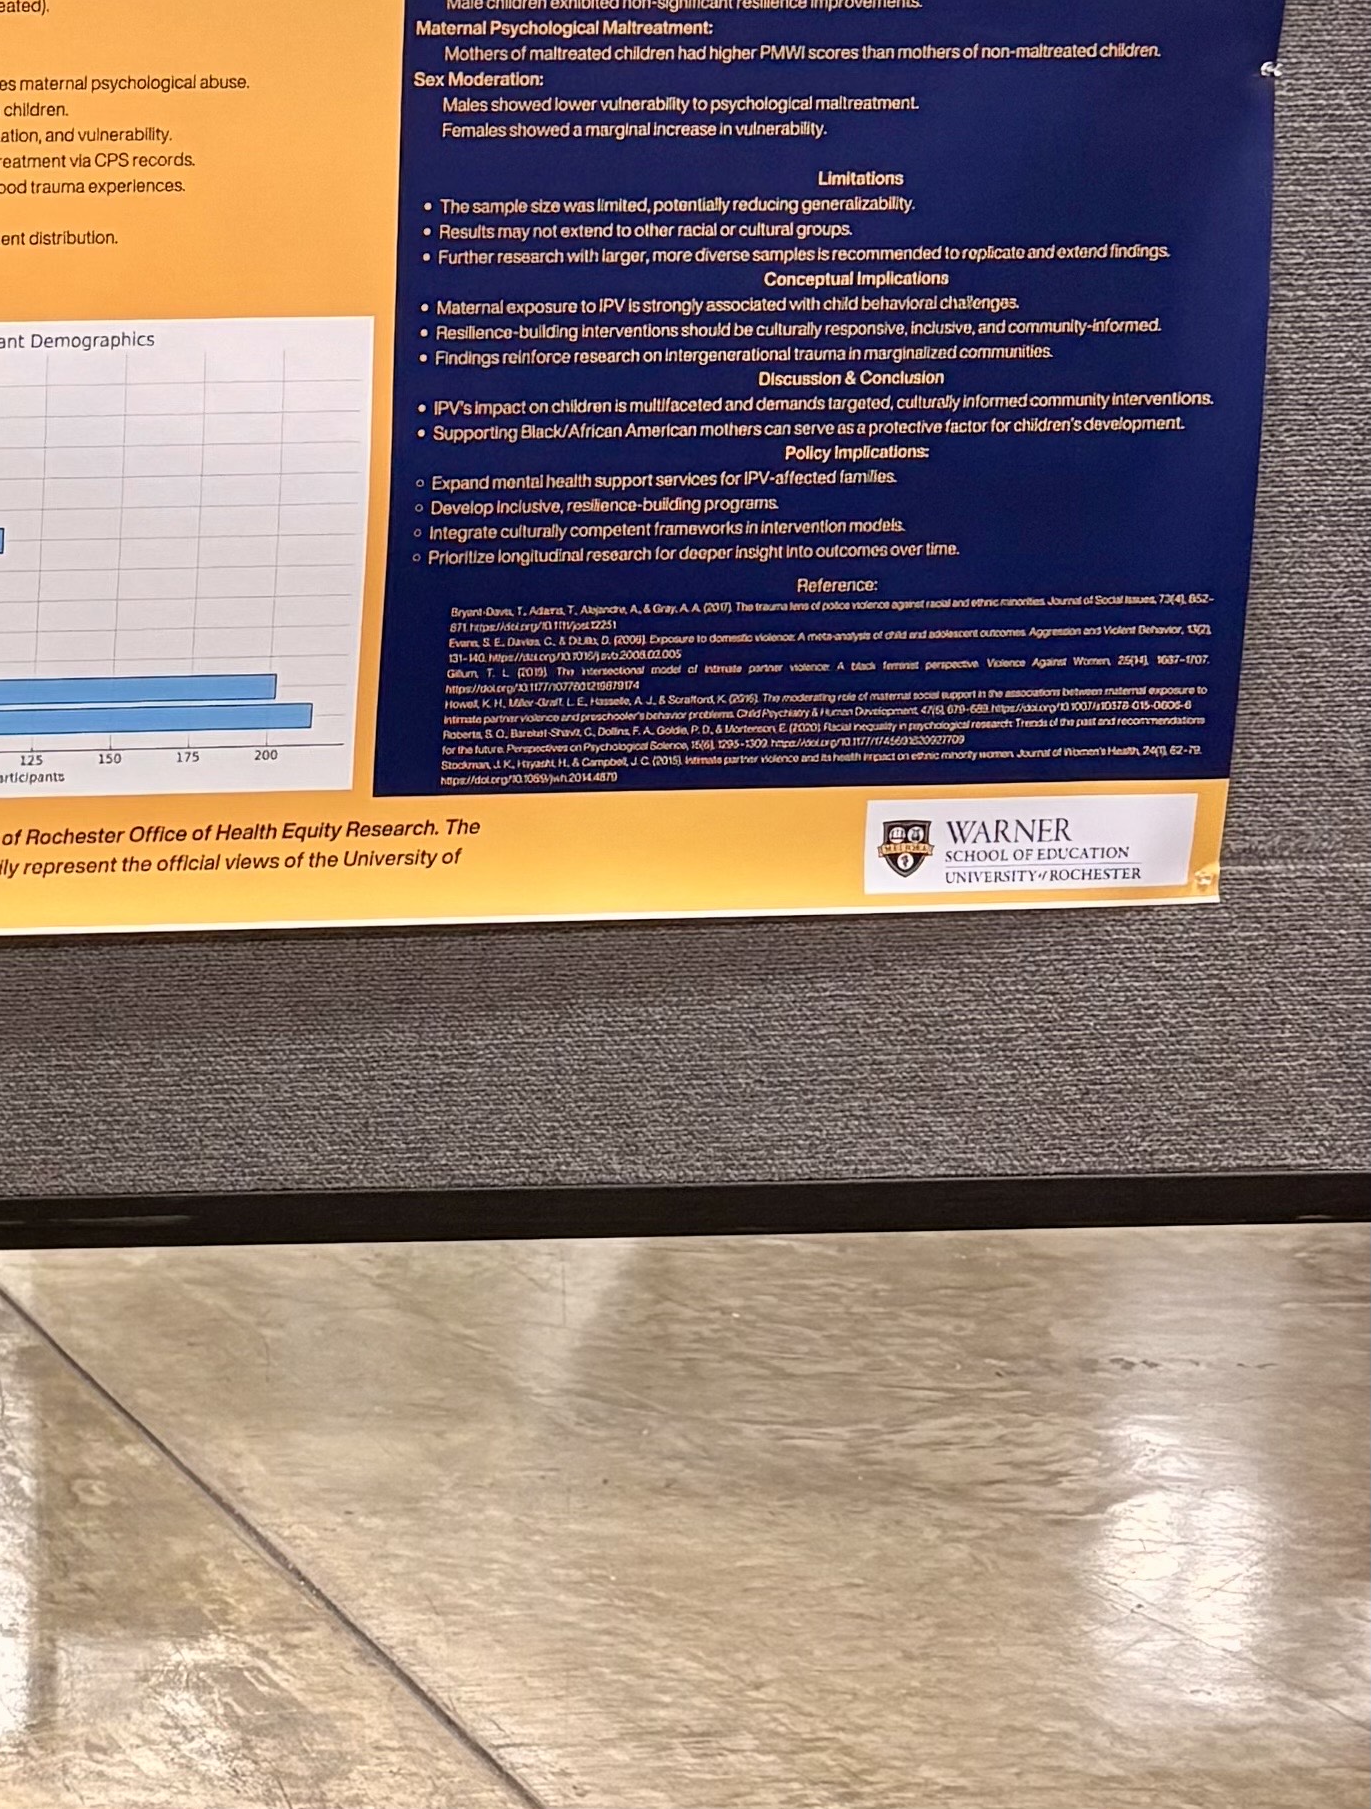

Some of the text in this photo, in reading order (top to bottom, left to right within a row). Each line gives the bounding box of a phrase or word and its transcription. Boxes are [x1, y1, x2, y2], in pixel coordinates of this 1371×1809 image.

[818, 170, 903, 185] Limitations
[30, 330, 154, 351] Demographics
[797, 577, 878, 592] Reference:
[20, 754, 43, 766] 125
[98, 752, 121, 764] 150
[176, 750, 199, 762] 175
[254, 749, 278, 760] 200
[946, 818, 1073, 844] WARNER
[945, 846, 1130, 862] SCHOOL OF EDUCATION
[945, 869, 1037, 884] UNIVERSITY
[1051, 867, 1142, 881] ROCHESTER
